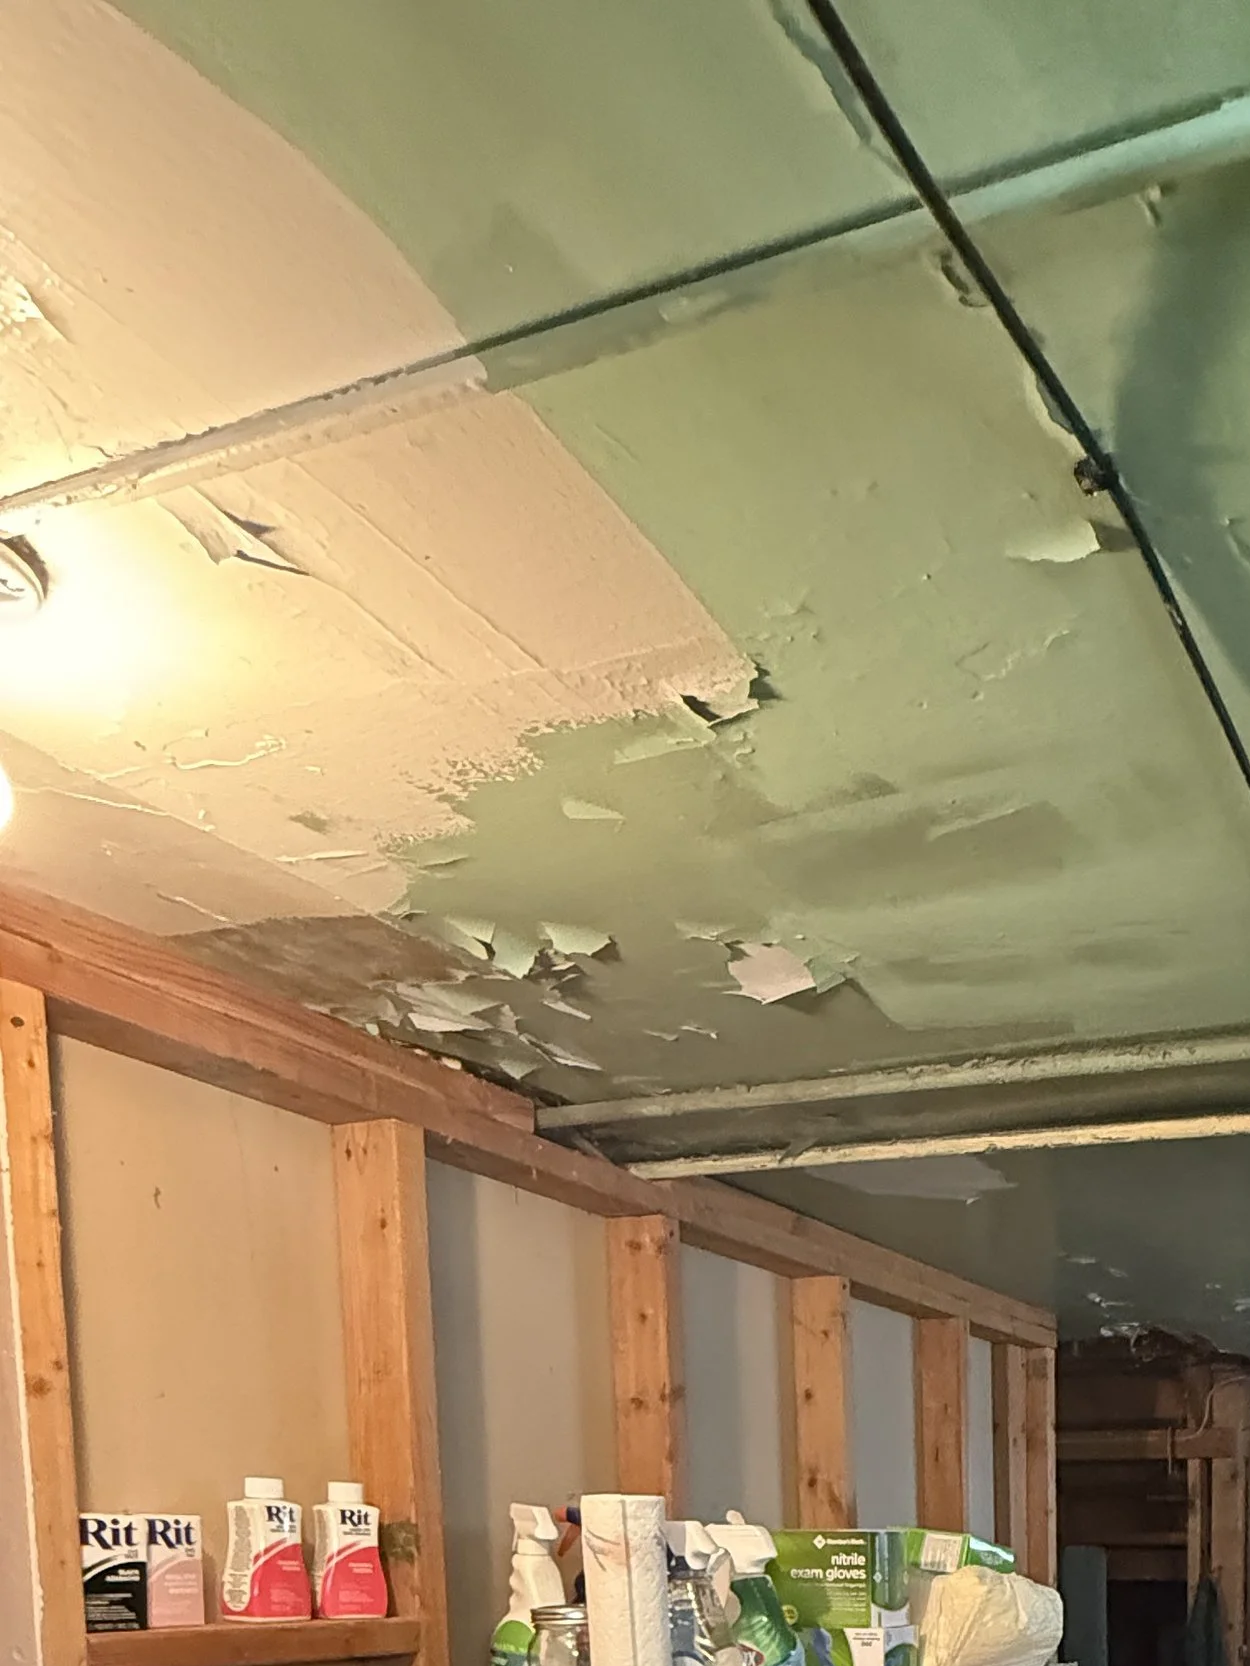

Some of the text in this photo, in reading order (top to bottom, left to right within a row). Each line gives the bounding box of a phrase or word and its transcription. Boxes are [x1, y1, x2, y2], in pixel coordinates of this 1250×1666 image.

[265, 1505, 297, 1525] Rit
[339, 1508, 371, 1527] Rit
[79, 1518, 141, 1551] Rit
[144, 1518, 197, 1549] Rit
[831, 1552, 866, 1566] nitrile
[790, 1566, 867, 1581] exam gloves
